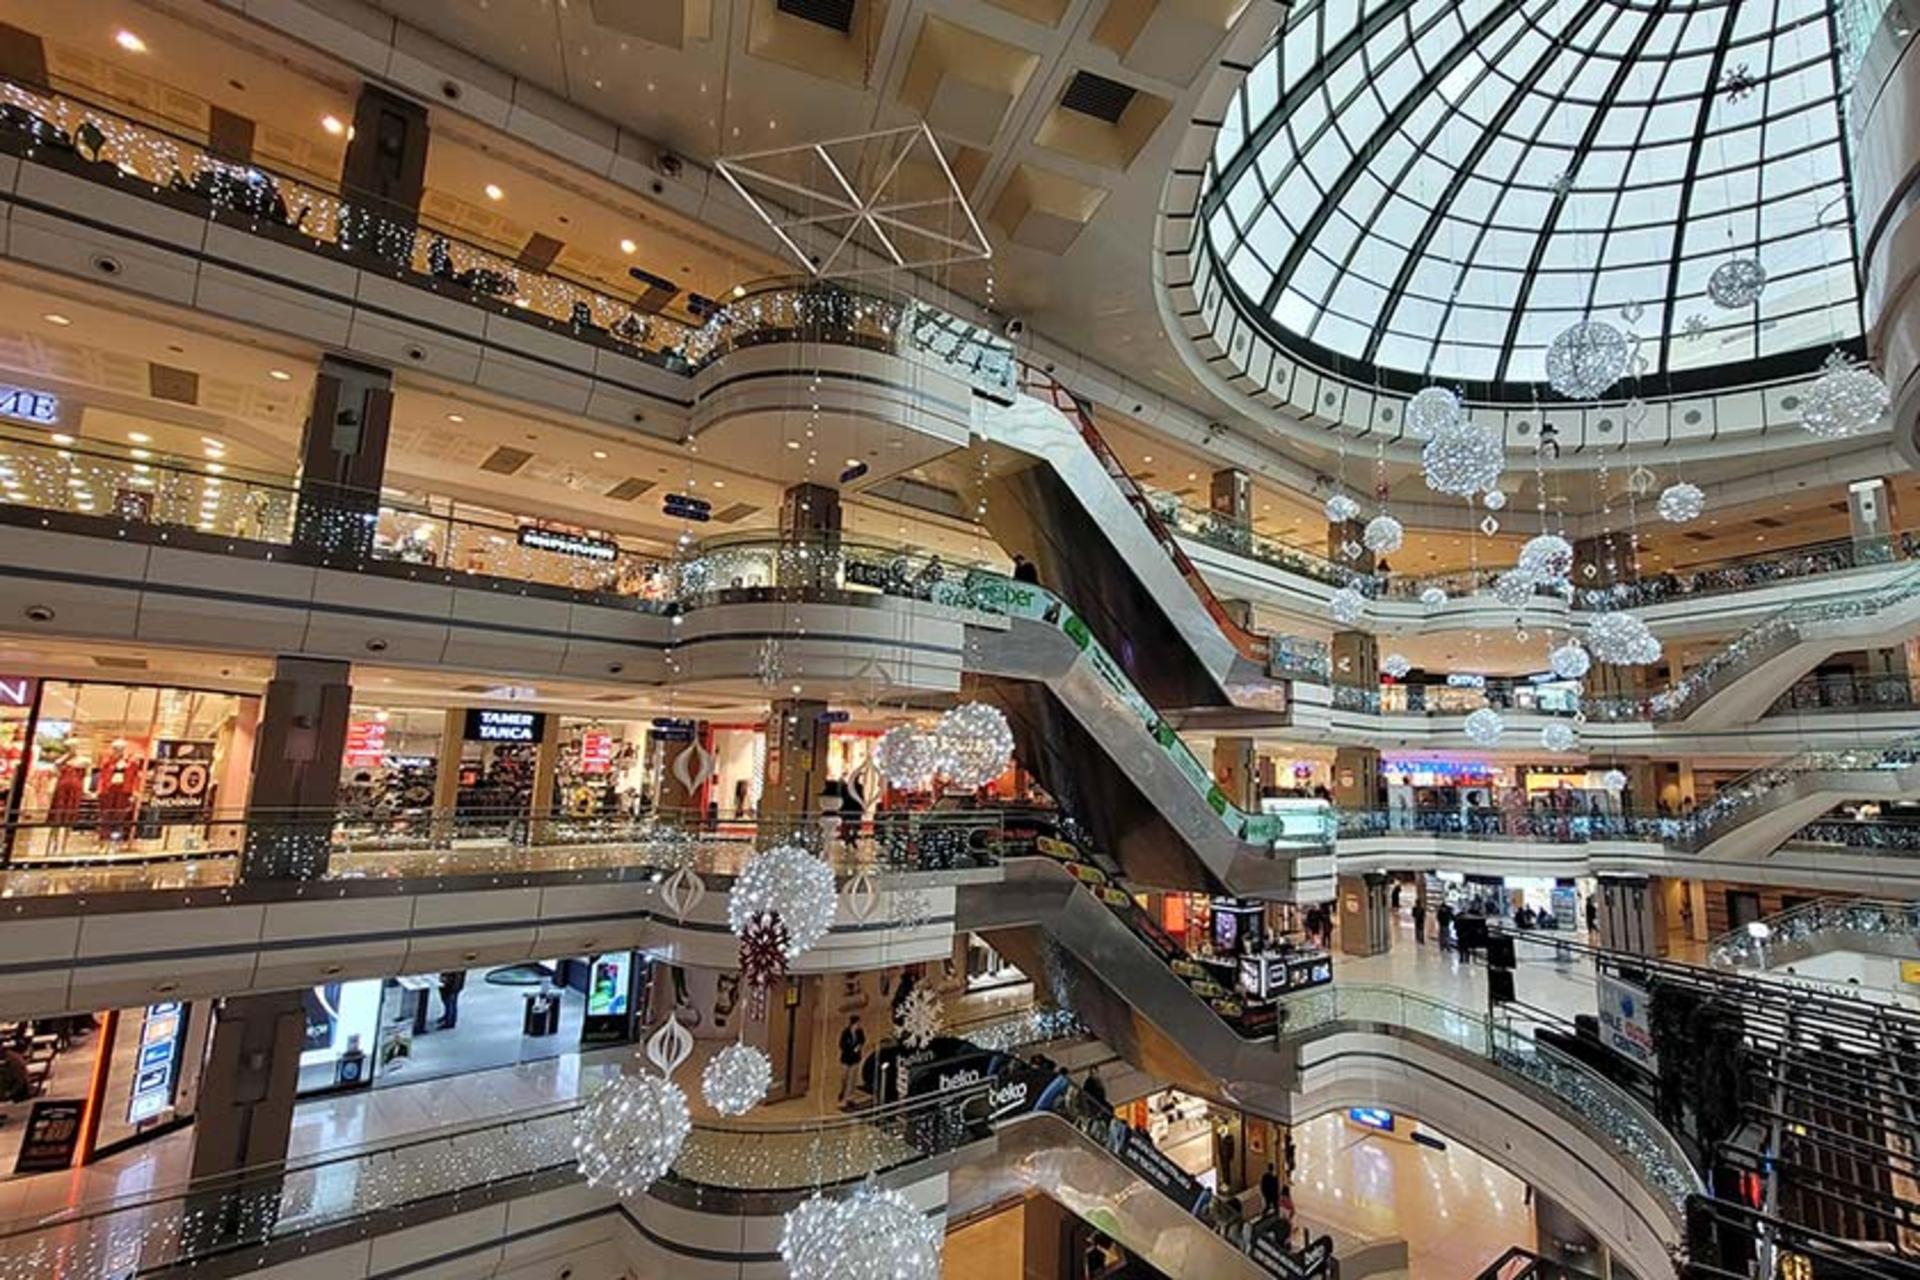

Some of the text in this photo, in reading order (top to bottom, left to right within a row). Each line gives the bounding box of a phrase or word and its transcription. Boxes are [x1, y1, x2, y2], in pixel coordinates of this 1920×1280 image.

[480, 712, 534, 726] TAMER
[479, 726, 533, 740] TANCA
[153, 765, 206, 796] 50
[939, 1069, 979, 1092] beko
[988, 1081, 1028, 1106] beko
